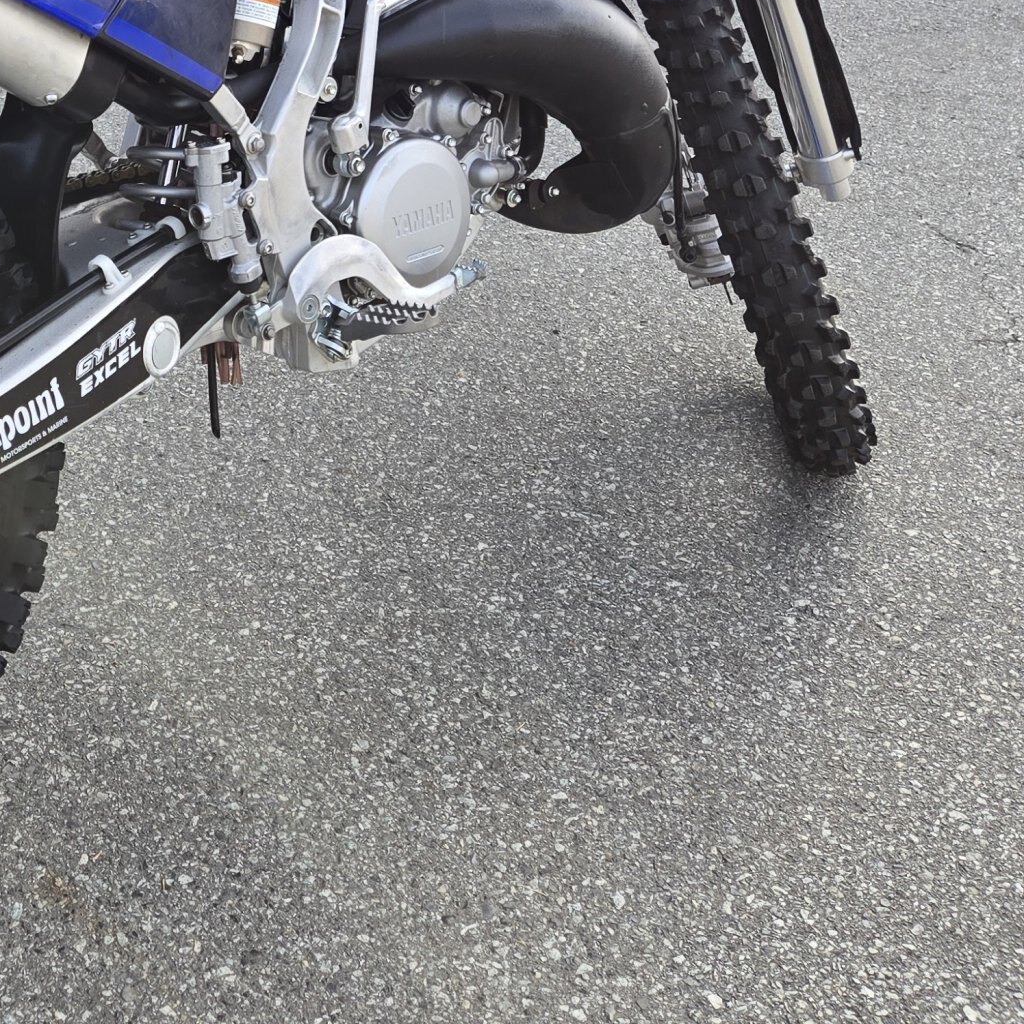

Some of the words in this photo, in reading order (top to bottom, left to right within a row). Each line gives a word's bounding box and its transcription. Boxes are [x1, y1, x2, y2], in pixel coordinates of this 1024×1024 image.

[392, 199, 455, 239] YAMAHA
[76, 318, 137, 380] GYTR
[78, 342, 141, 397] EXCEL
[0, 431, 43, 463] MOTORSPORTS
[48, 415, 69, 434] MARINE
